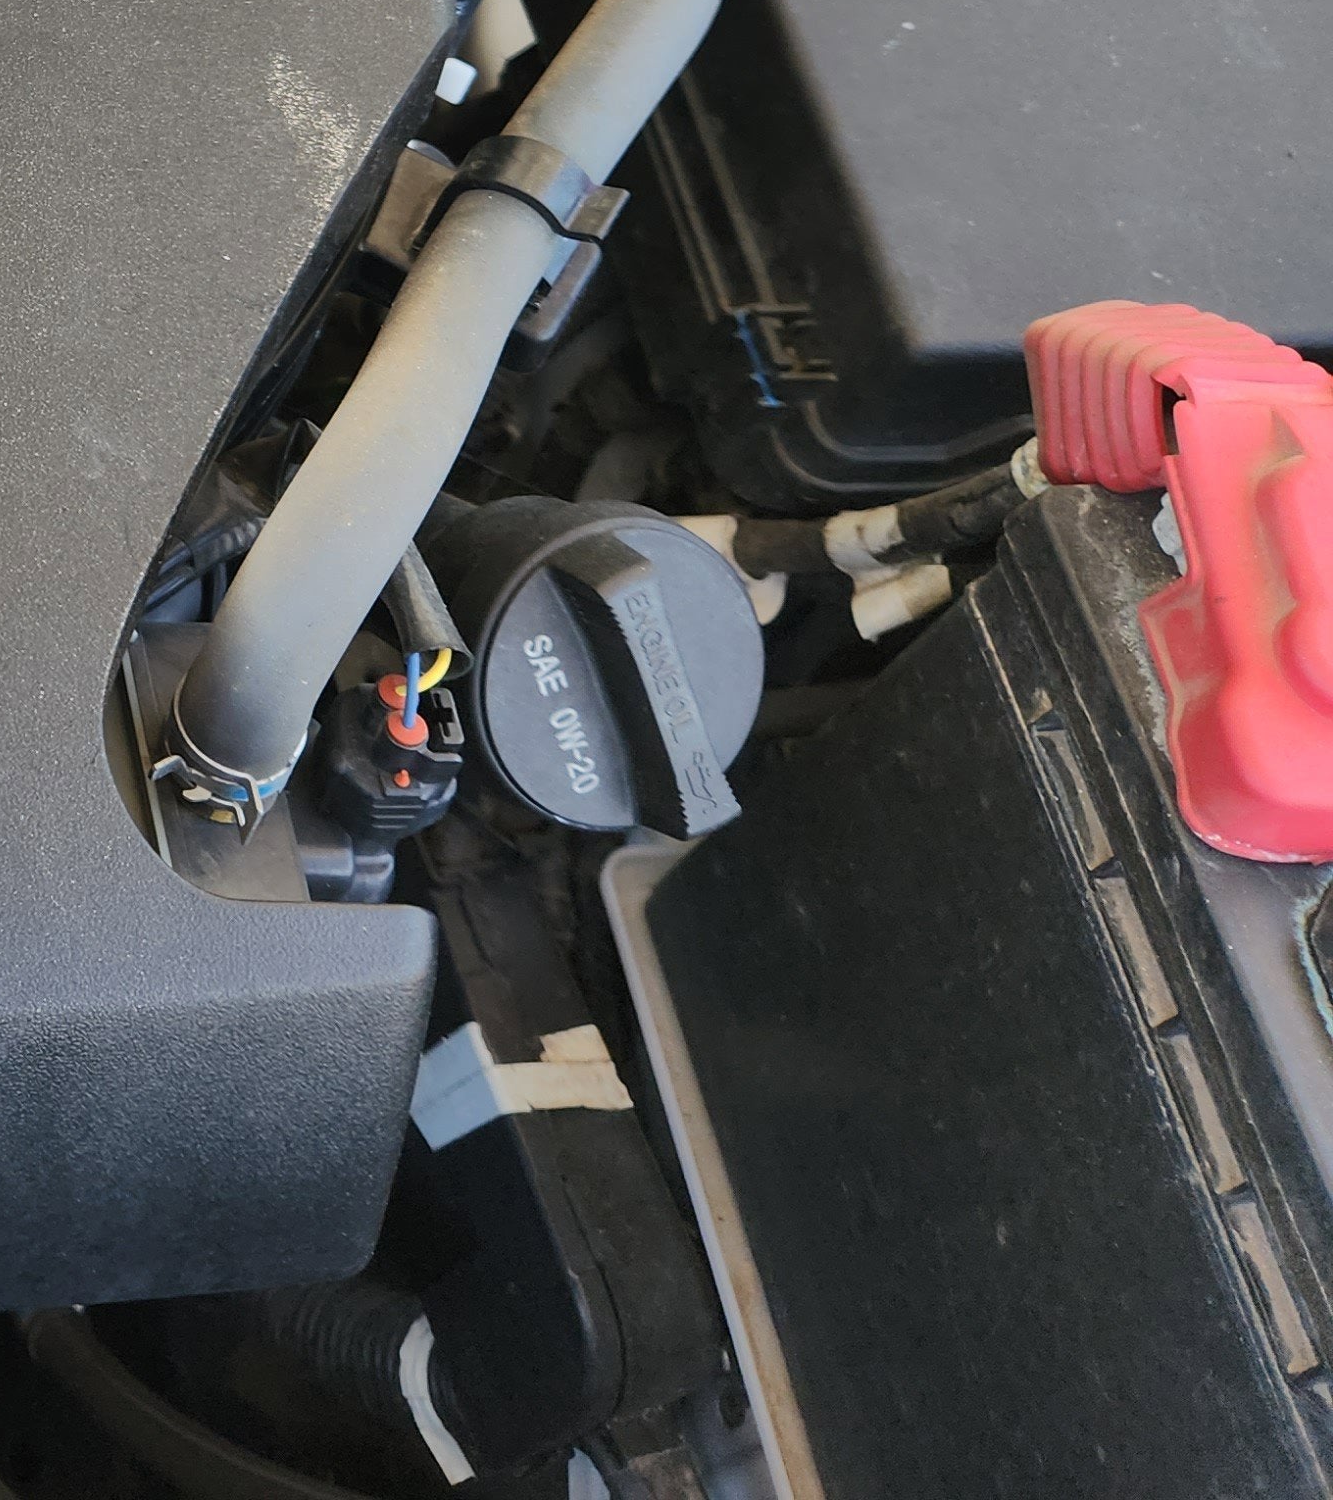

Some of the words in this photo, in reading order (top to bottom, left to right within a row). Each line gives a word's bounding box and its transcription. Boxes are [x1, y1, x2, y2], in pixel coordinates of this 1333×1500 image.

[522, 634, 569, 697] SAE
[549, 707, 600, 794] 0W-20
[623, 590, 679, 695] ENGINE
[664, 699, 694, 744] OIL
